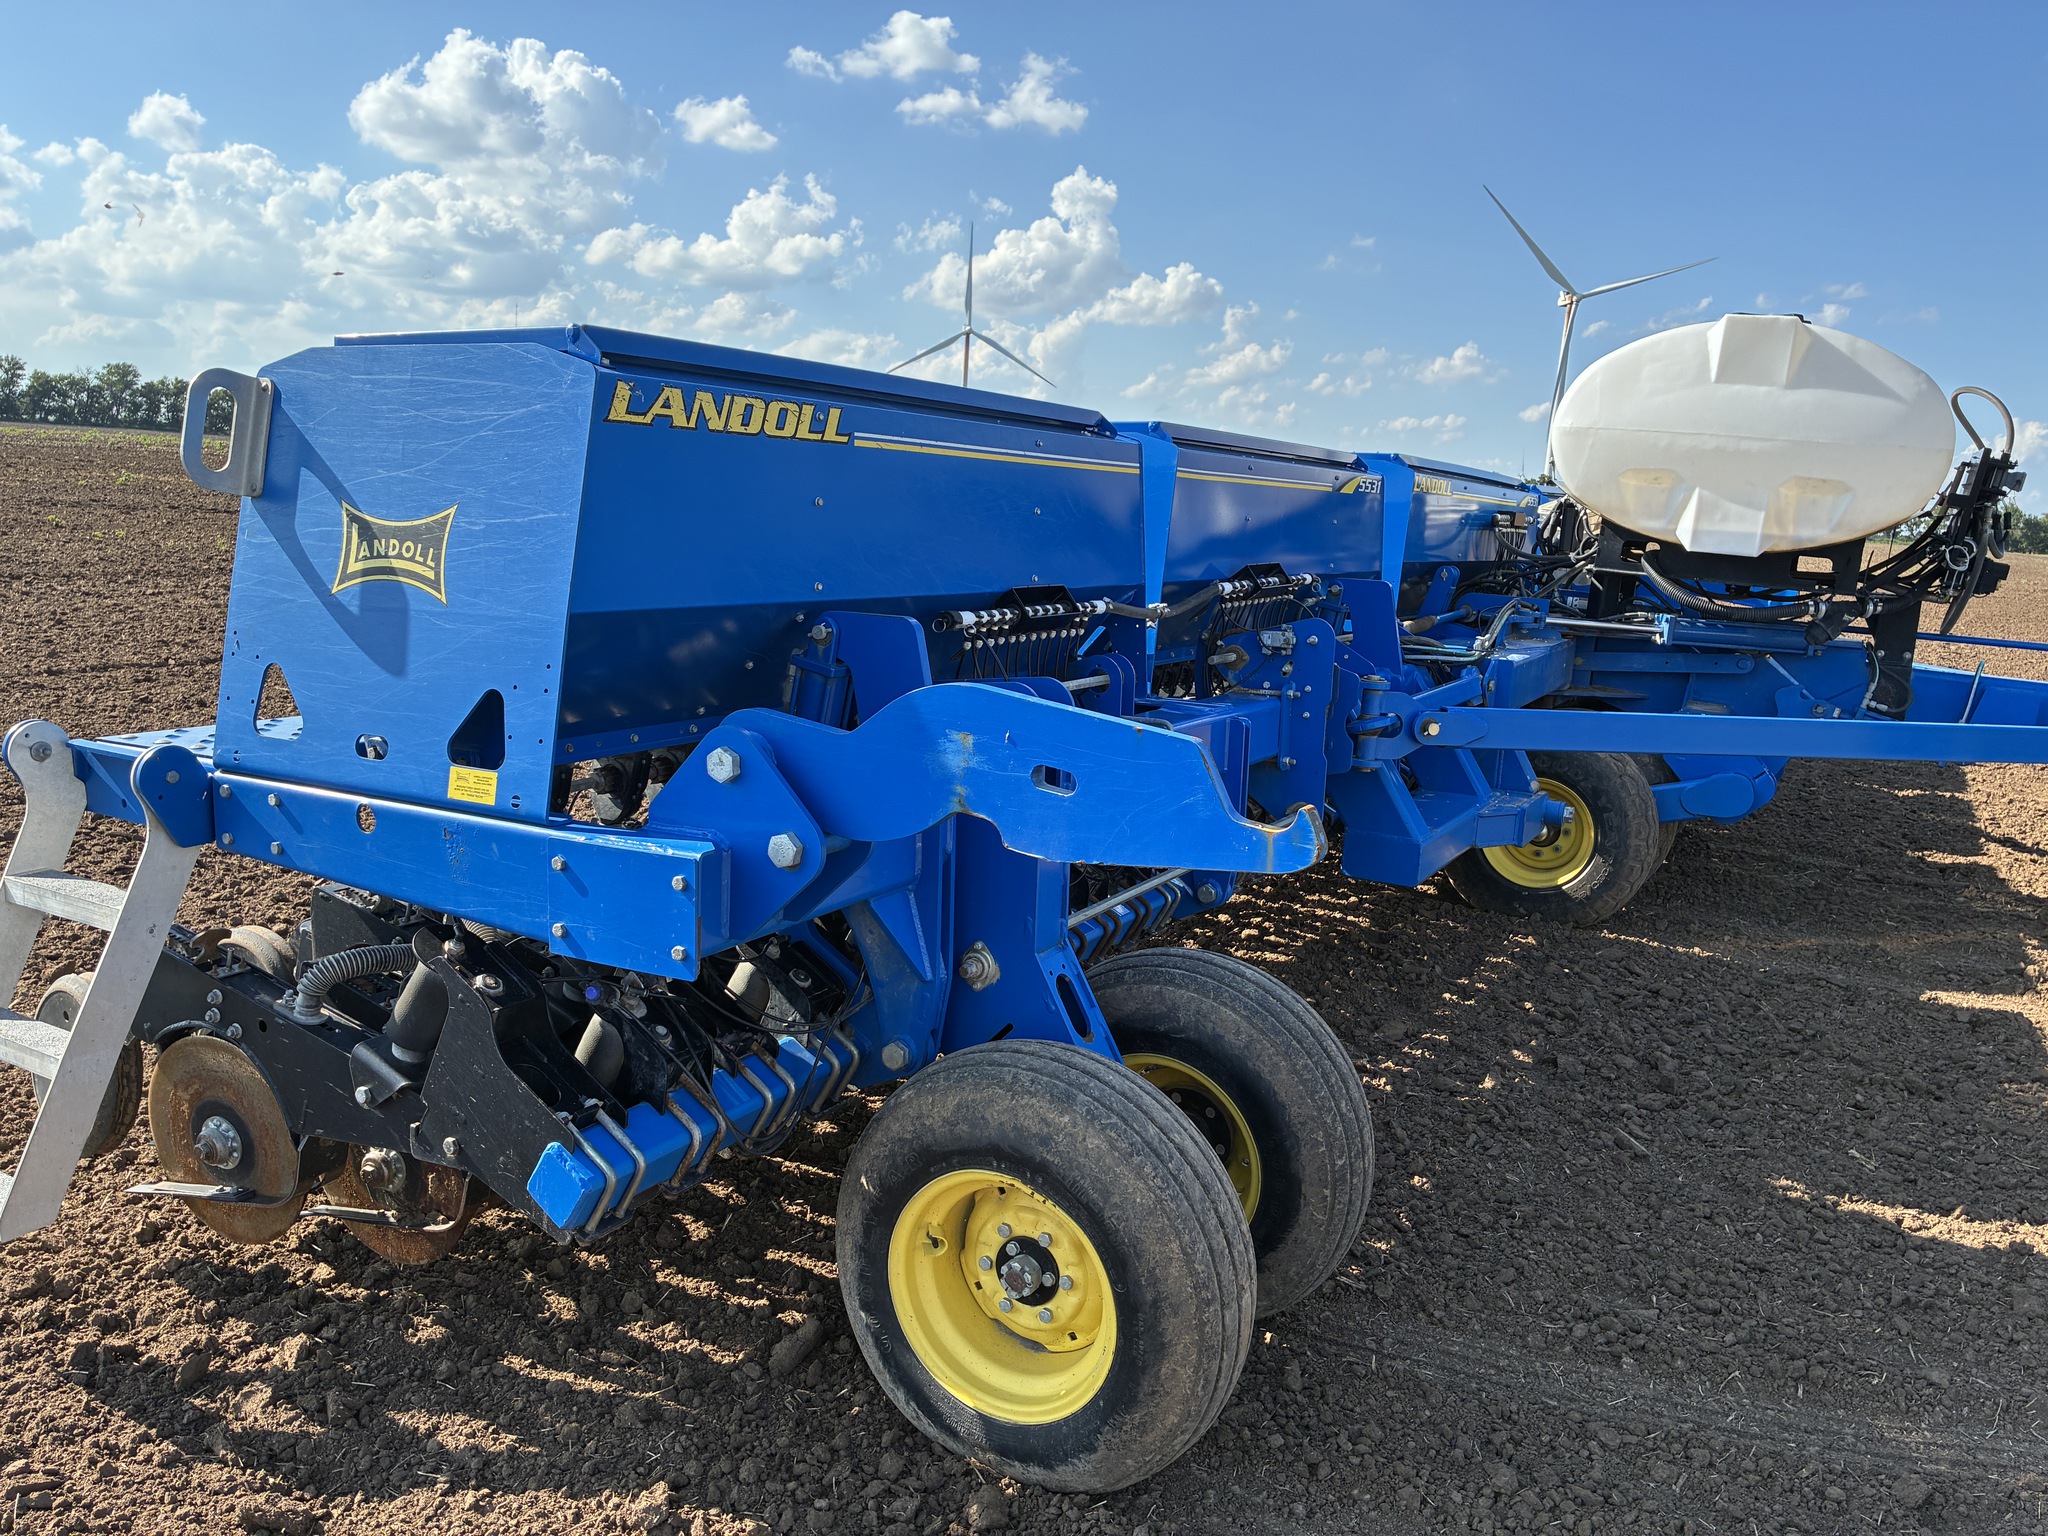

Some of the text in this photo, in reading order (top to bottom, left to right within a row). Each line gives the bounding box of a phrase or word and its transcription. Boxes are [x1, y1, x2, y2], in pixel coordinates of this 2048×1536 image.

[603, 379, 852, 445] LANDOLL
[1358, 478, 1382, 494] 5531
[1413, 475, 1453, 496] LANDOLL
[347, 522, 435, 581] LANDOLL
